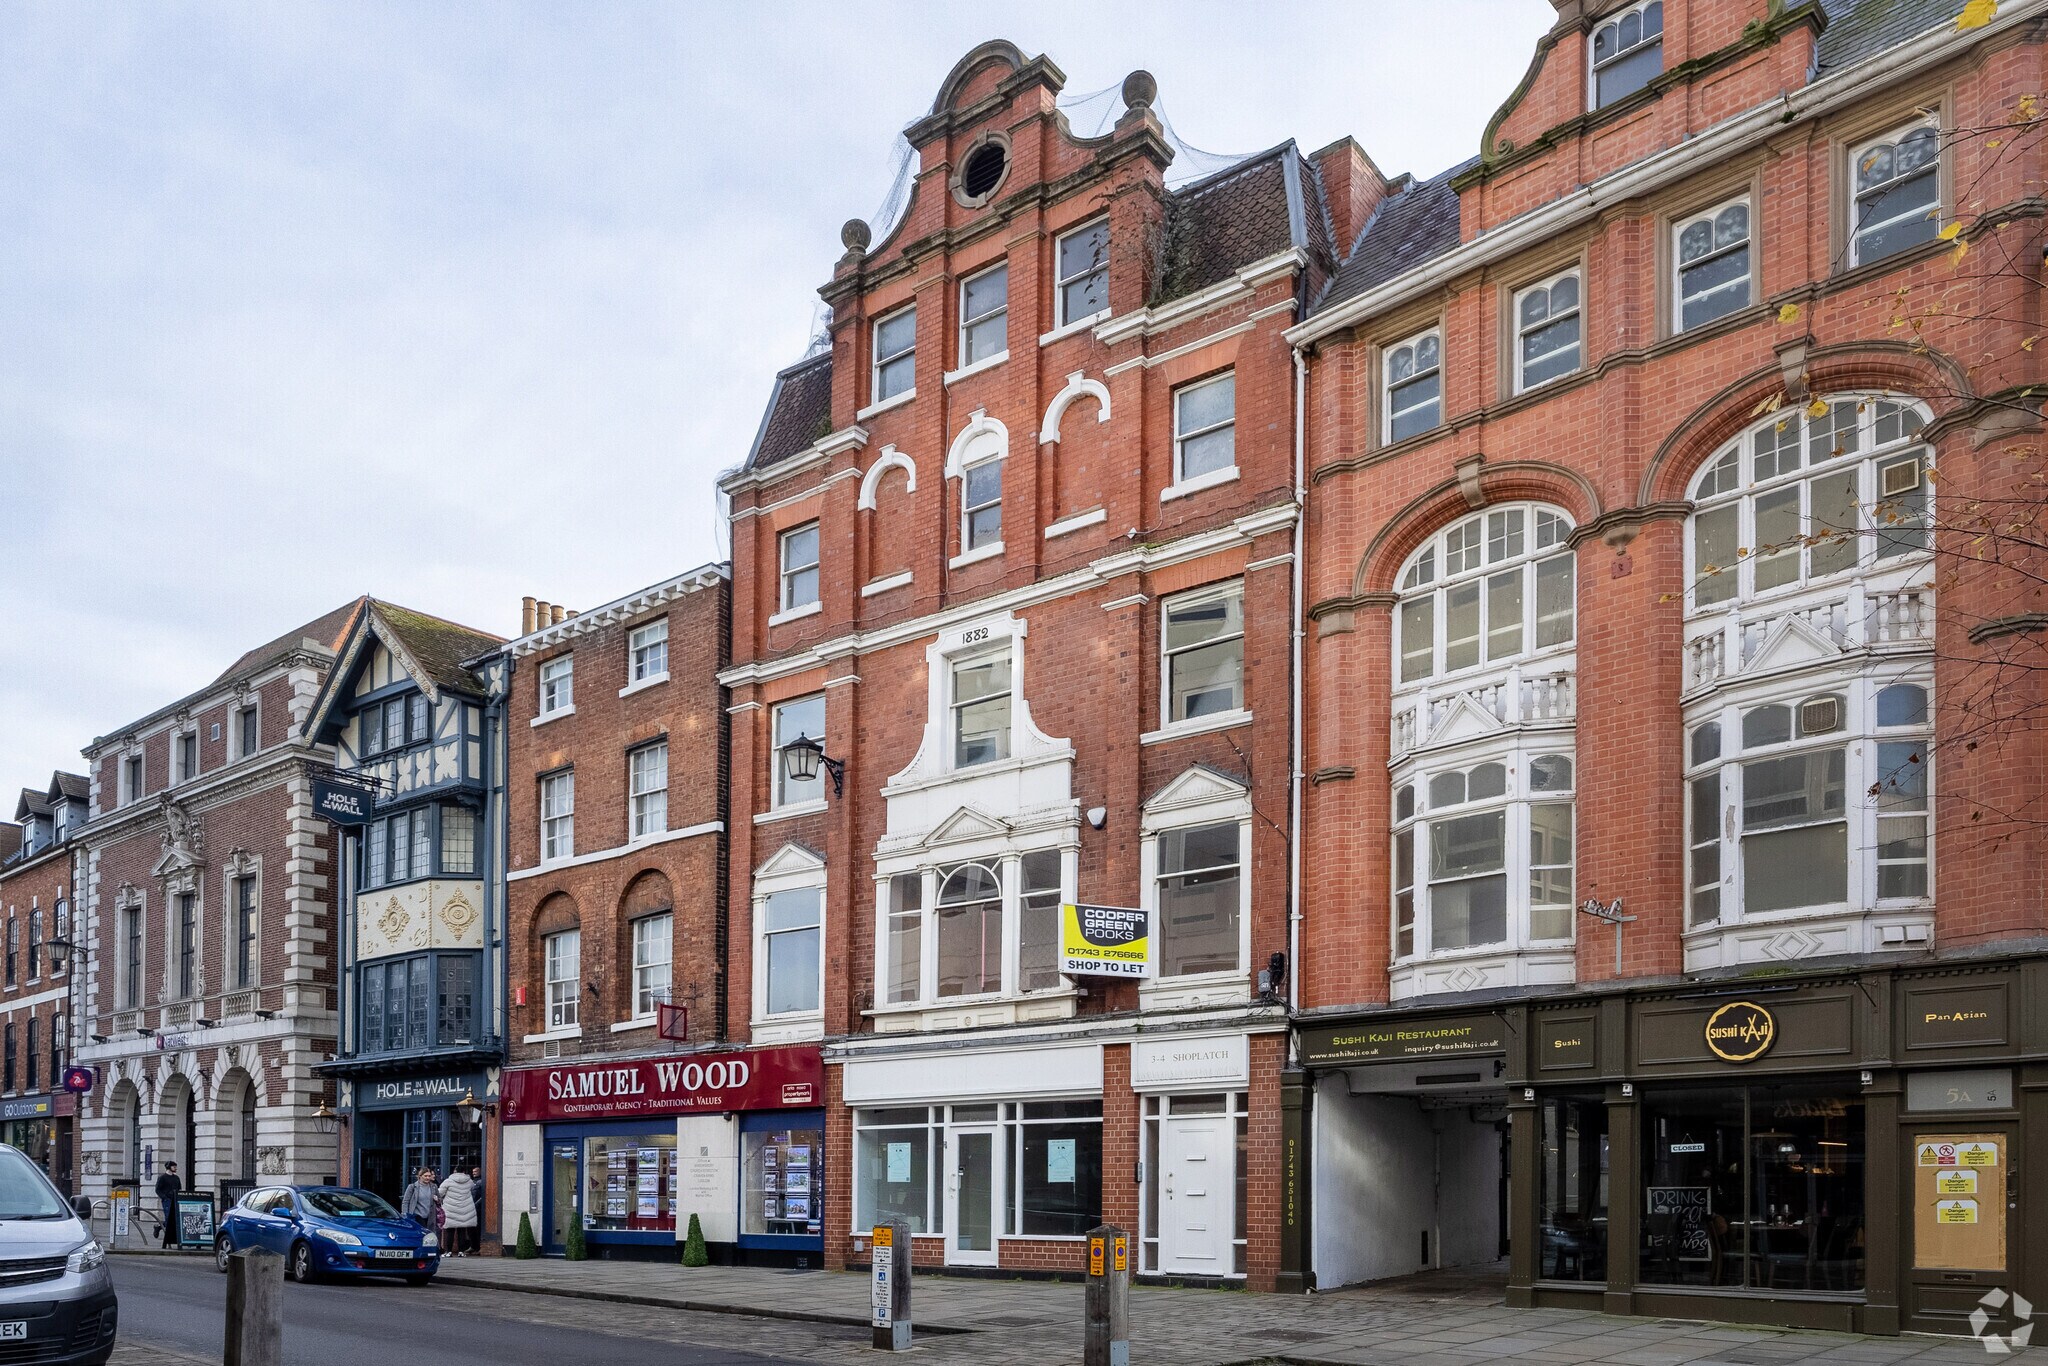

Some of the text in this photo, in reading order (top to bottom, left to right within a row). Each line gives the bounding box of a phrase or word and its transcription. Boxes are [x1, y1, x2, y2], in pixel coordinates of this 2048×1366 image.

[962, 627, 989, 645] 1882
[327, 791, 358, 806] HOLE
[330, 801, 363, 816] WALL
[1084, 909, 1145, 922] COOPER
[1084, 918, 1134, 931] GREEN
[1085, 928, 1135, 940] POOKS
[1067, 947, 1144, 959] 01743 276666
[1068, 960, 1144, 974] SHOP TO LET
[1925, 1010, 1987, 1023] Pan Asian
[1554, 1038, 1581, 1048] Sushi
[1151, 1050, 1229, 1064] 3-4 SHOPLATCH
[549, 1060, 749, 1100] SAMUEL WOOD
[377, 1081, 412, 1098] HOLE
[413, 1088, 424, 1096] THE
[424, 1077, 465, 1094] WALL
[1946, 1088, 1971, 1104] 5A
[1652, 1190, 1706, 1205] DRINK
[0, 1323, 23, 1337] EK
